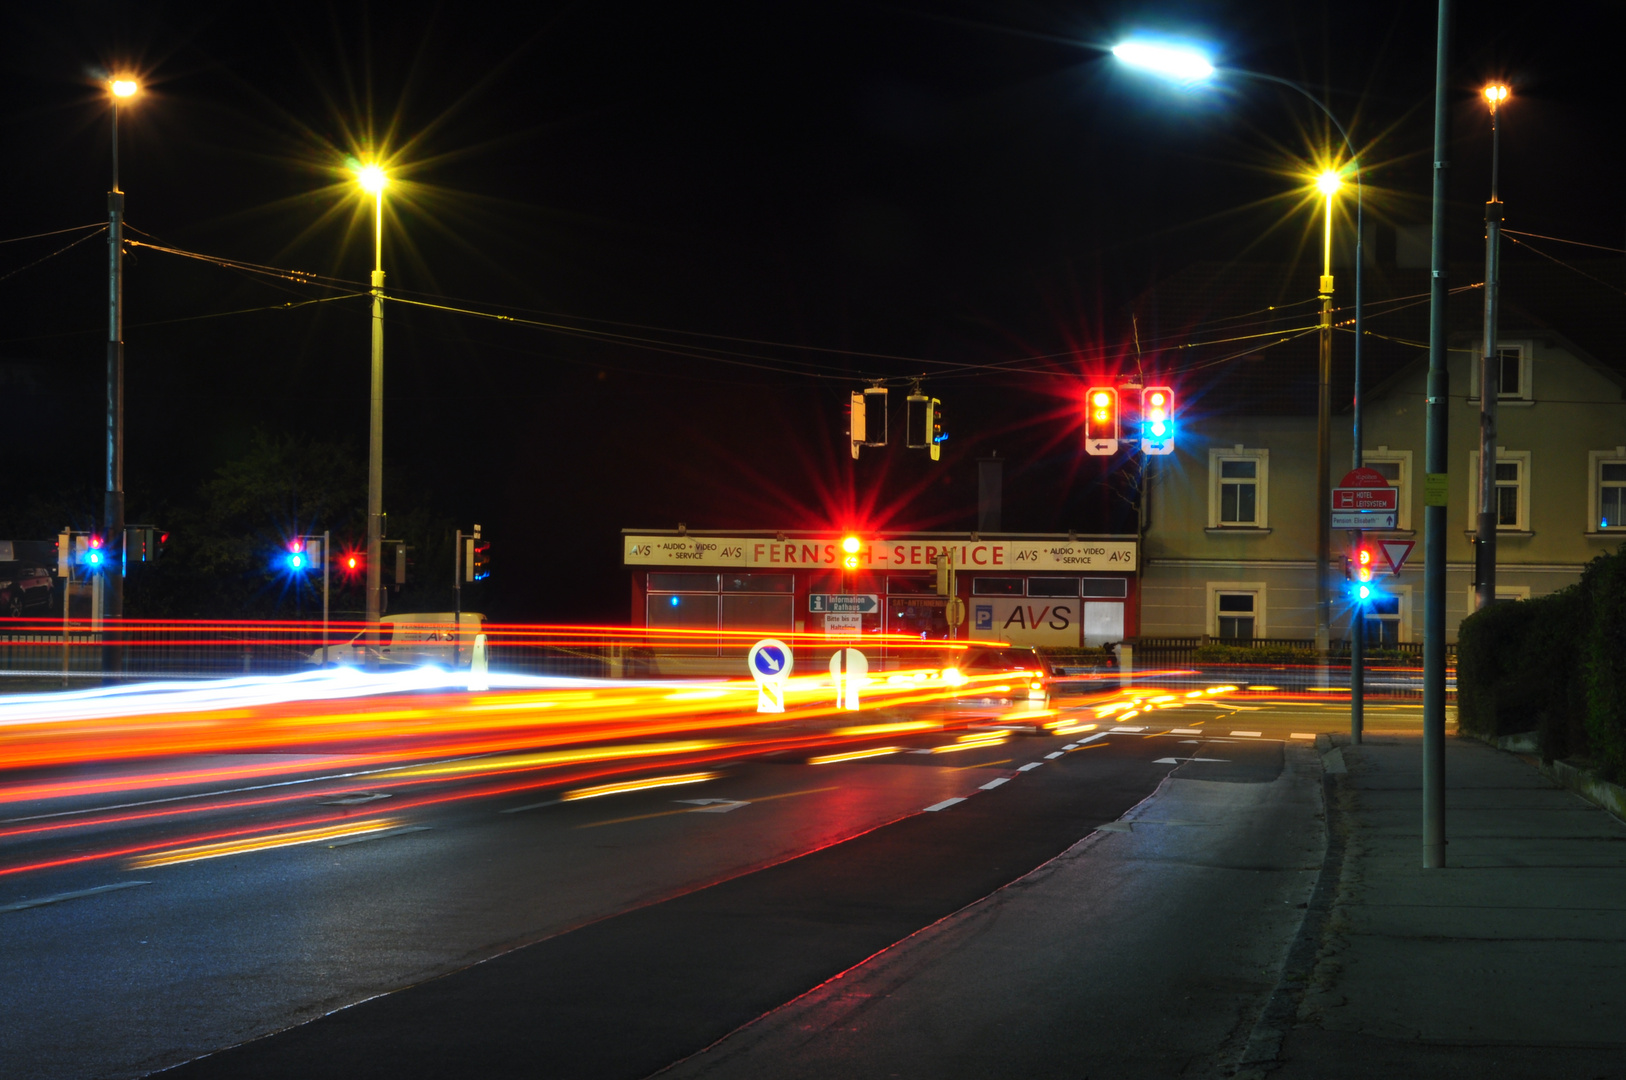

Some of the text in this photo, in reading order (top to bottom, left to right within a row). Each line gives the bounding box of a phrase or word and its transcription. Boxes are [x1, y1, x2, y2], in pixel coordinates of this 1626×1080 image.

[629, 544, 651, 556] AVS
[695, 543, 717, 551] VIDEO
[720, 547, 742, 558] AVS
[675, 552, 703, 560] SERVICE
[754, 543, 1004, 565] FERNSH-SERVICE
[1016, 550, 1038, 561] AVS
[1108, 551, 1131, 562] AVS
[829, 596, 865, 604] Information
[833, 603, 860, 611] Rathaus
[1003, 605, 1071, 630] AVS
[426, 630, 455, 642] AVS
